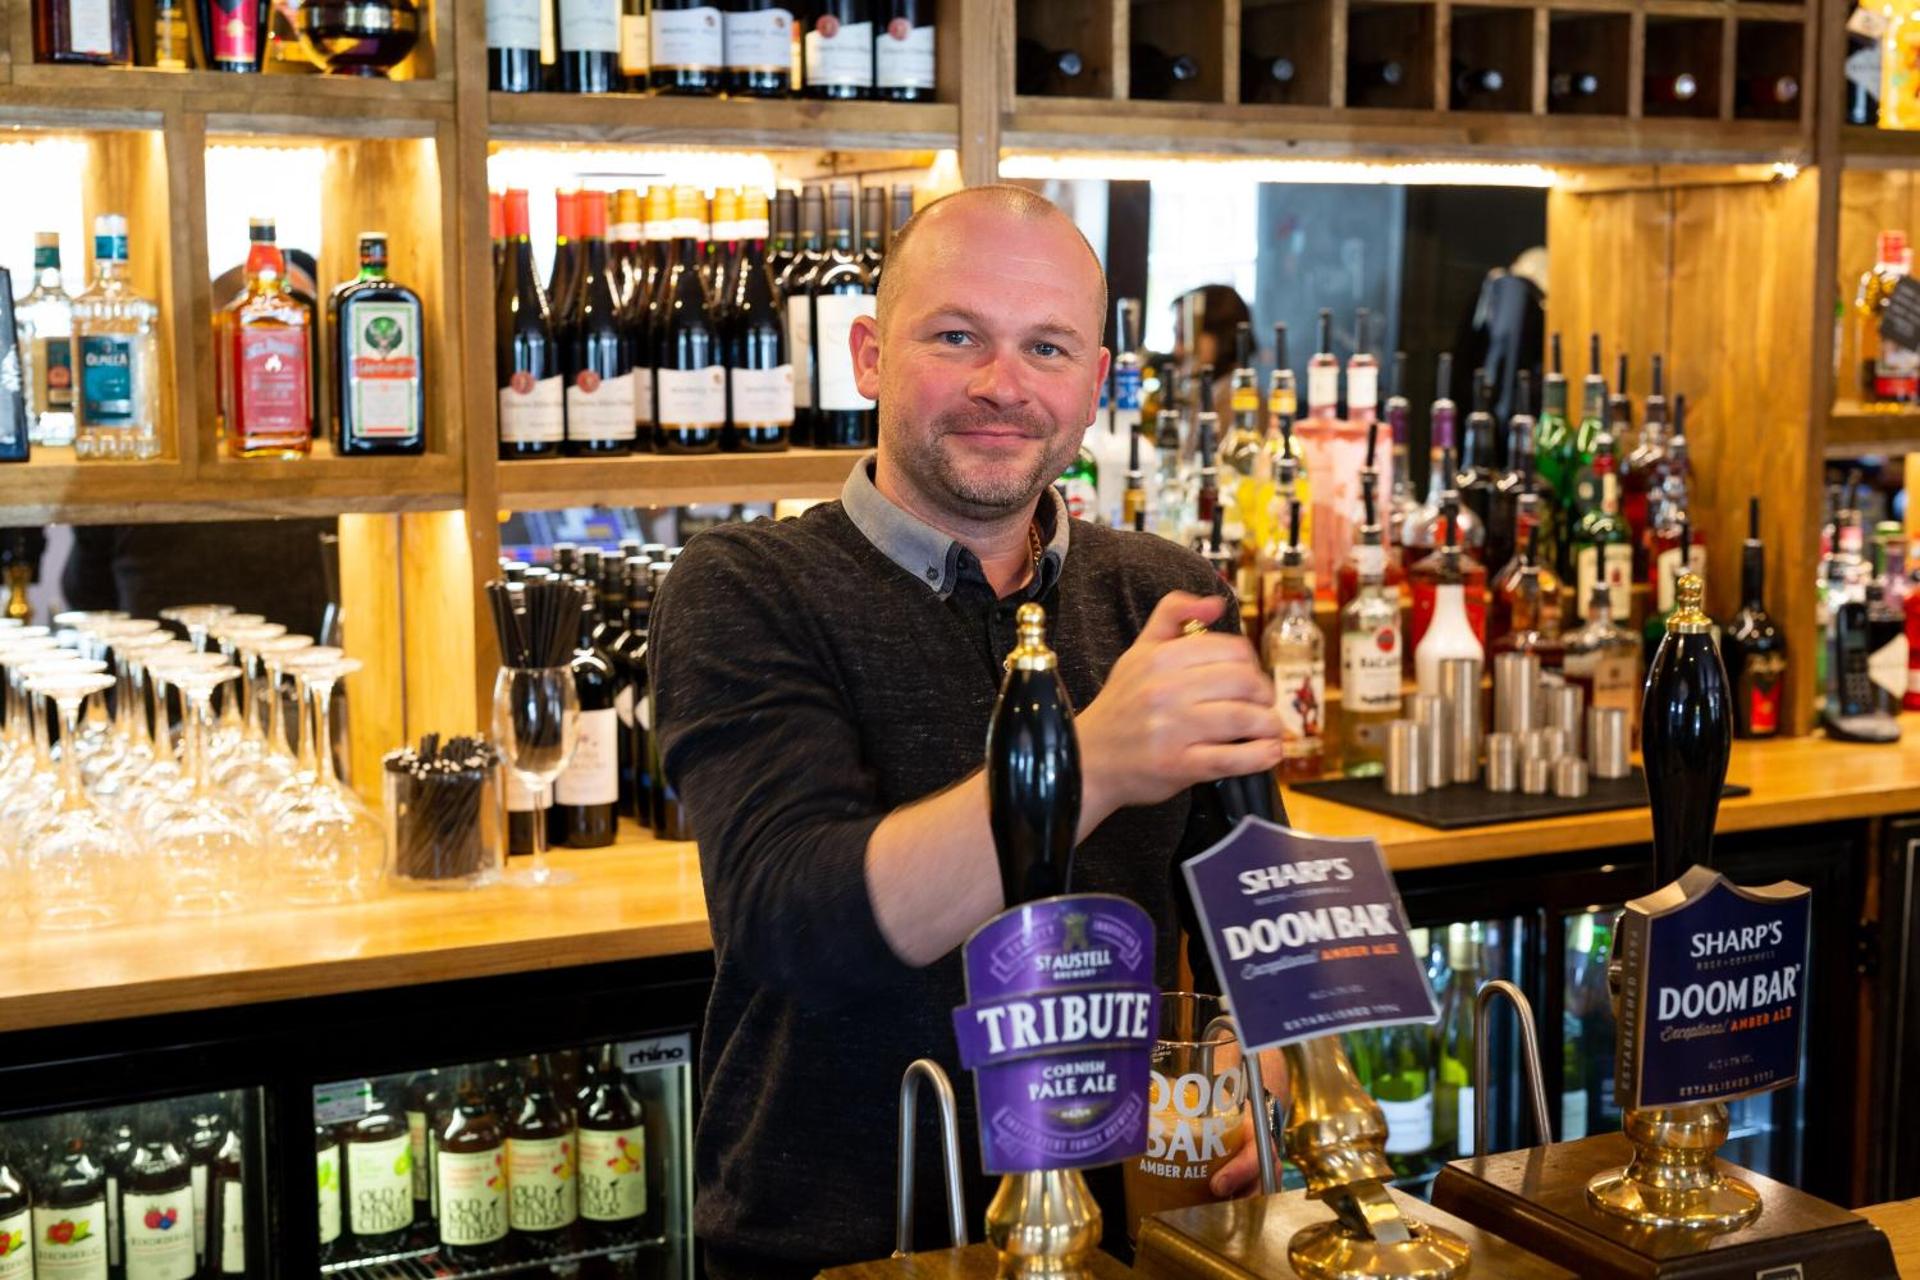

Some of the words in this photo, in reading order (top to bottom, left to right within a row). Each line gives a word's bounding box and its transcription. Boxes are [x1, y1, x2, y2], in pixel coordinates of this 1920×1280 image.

[1238, 858, 1354, 895] SHARP'S
[1222, 909, 1336, 960] DOOM
[1330, 904, 1398, 939] BAR
[1690, 920, 1783, 958] SHARP'S
[1052, 949, 1112, 970] AUSTELL
[1658, 977, 1748, 1022] DOOM
[1752, 966, 1797, 1009] BAR
[976, 992, 1150, 1055] TRIBUTE
[1730, 1013, 1769, 1033] AMBER
[1772, 1006, 1793, 1023] ALE
[629, 1040, 684, 1065] rhino
[1042, 1061, 1106, 1080] CORNISH
[1028, 1079, 1078, 1101] PALE
[1081, 1074, 1117, 1094] ALE
[1140, 1158, 1181, 1178] AMBER
[1184, 1164, 1208, 1179] ALE
